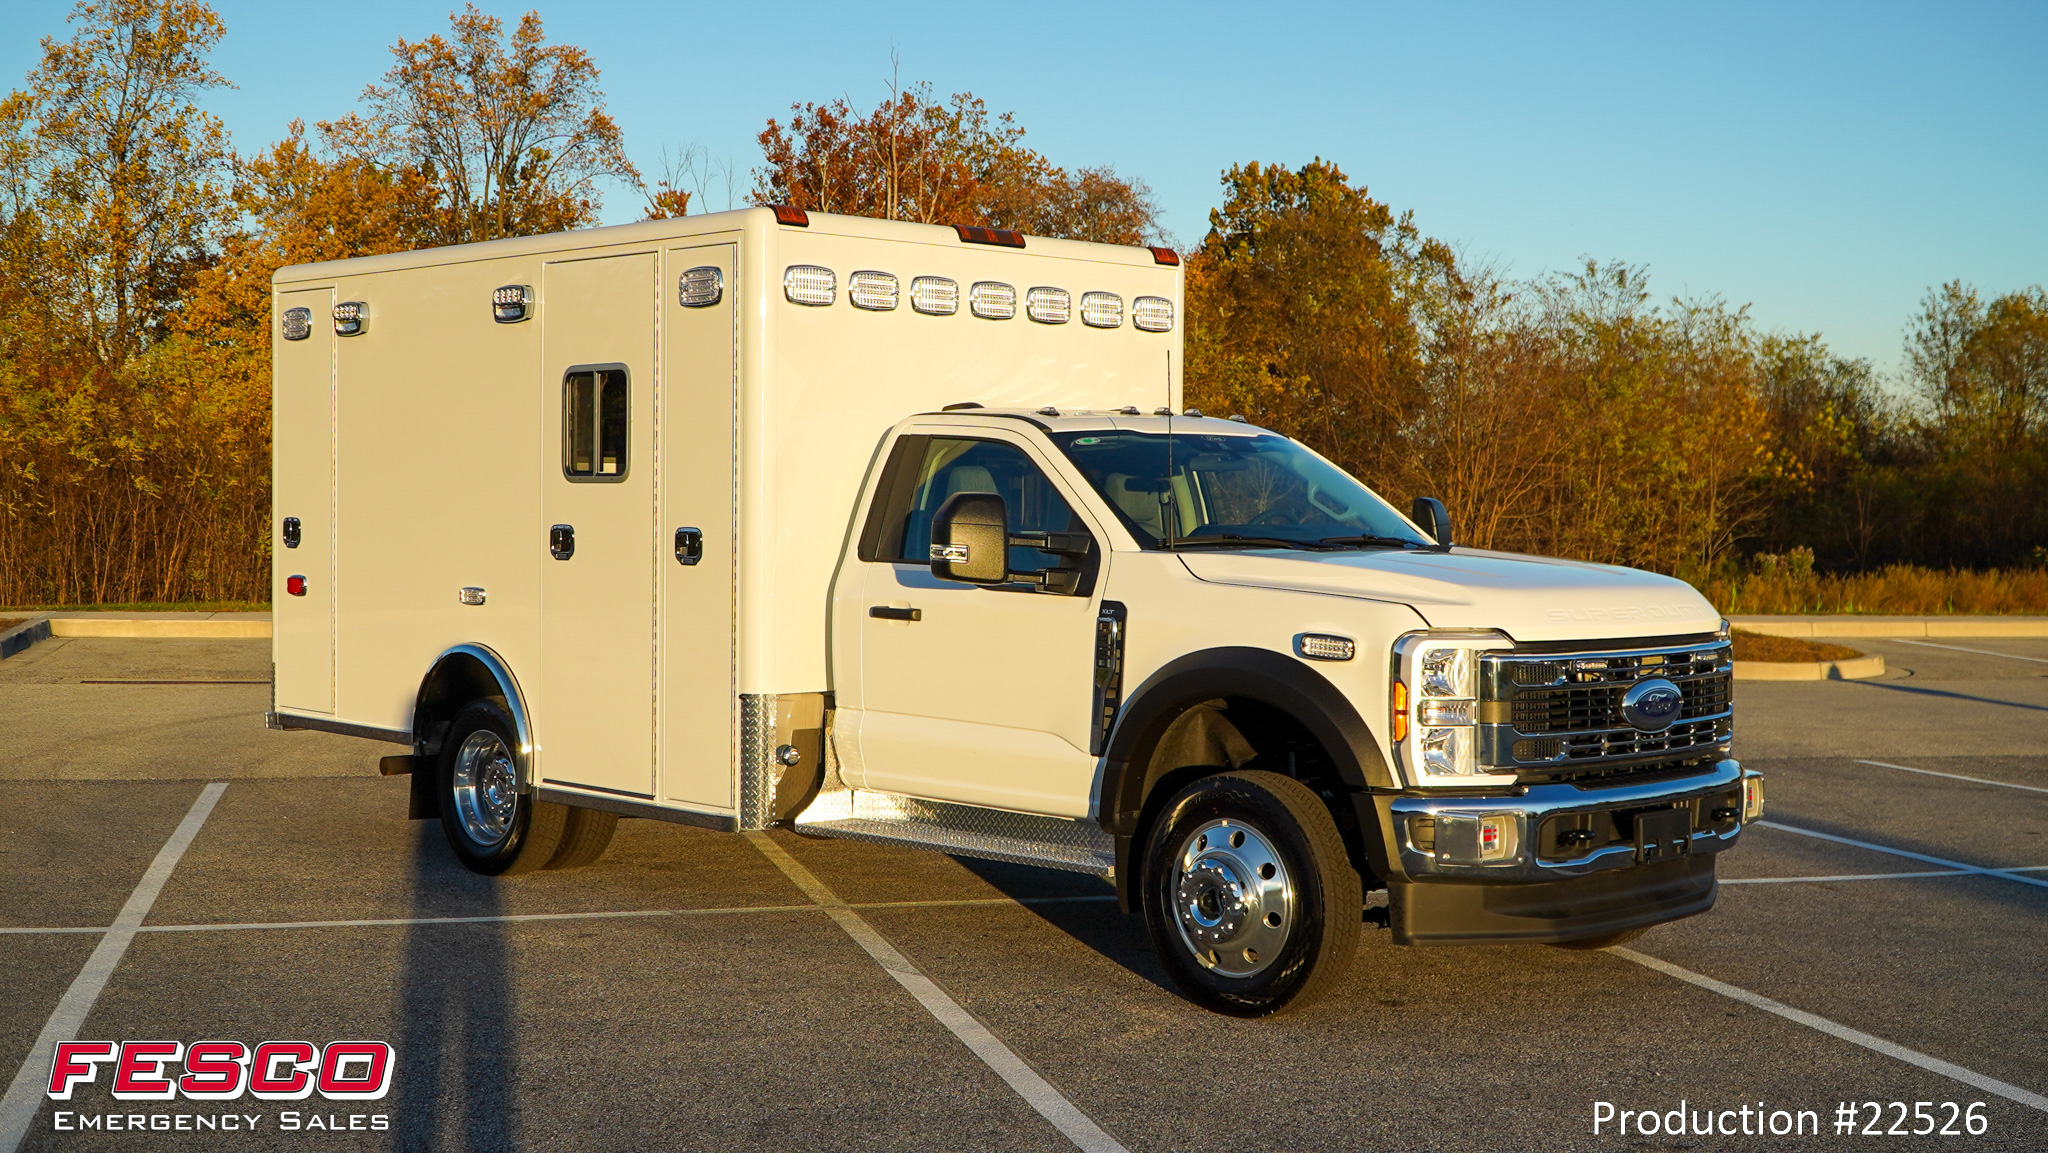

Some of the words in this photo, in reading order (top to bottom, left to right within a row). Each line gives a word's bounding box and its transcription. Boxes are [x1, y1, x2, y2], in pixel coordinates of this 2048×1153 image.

[1548, 607, 1647, 622] SUPER
[1648, 603, 1703, 618] DUTY
[1645, 692, 1673, 713] Ford
